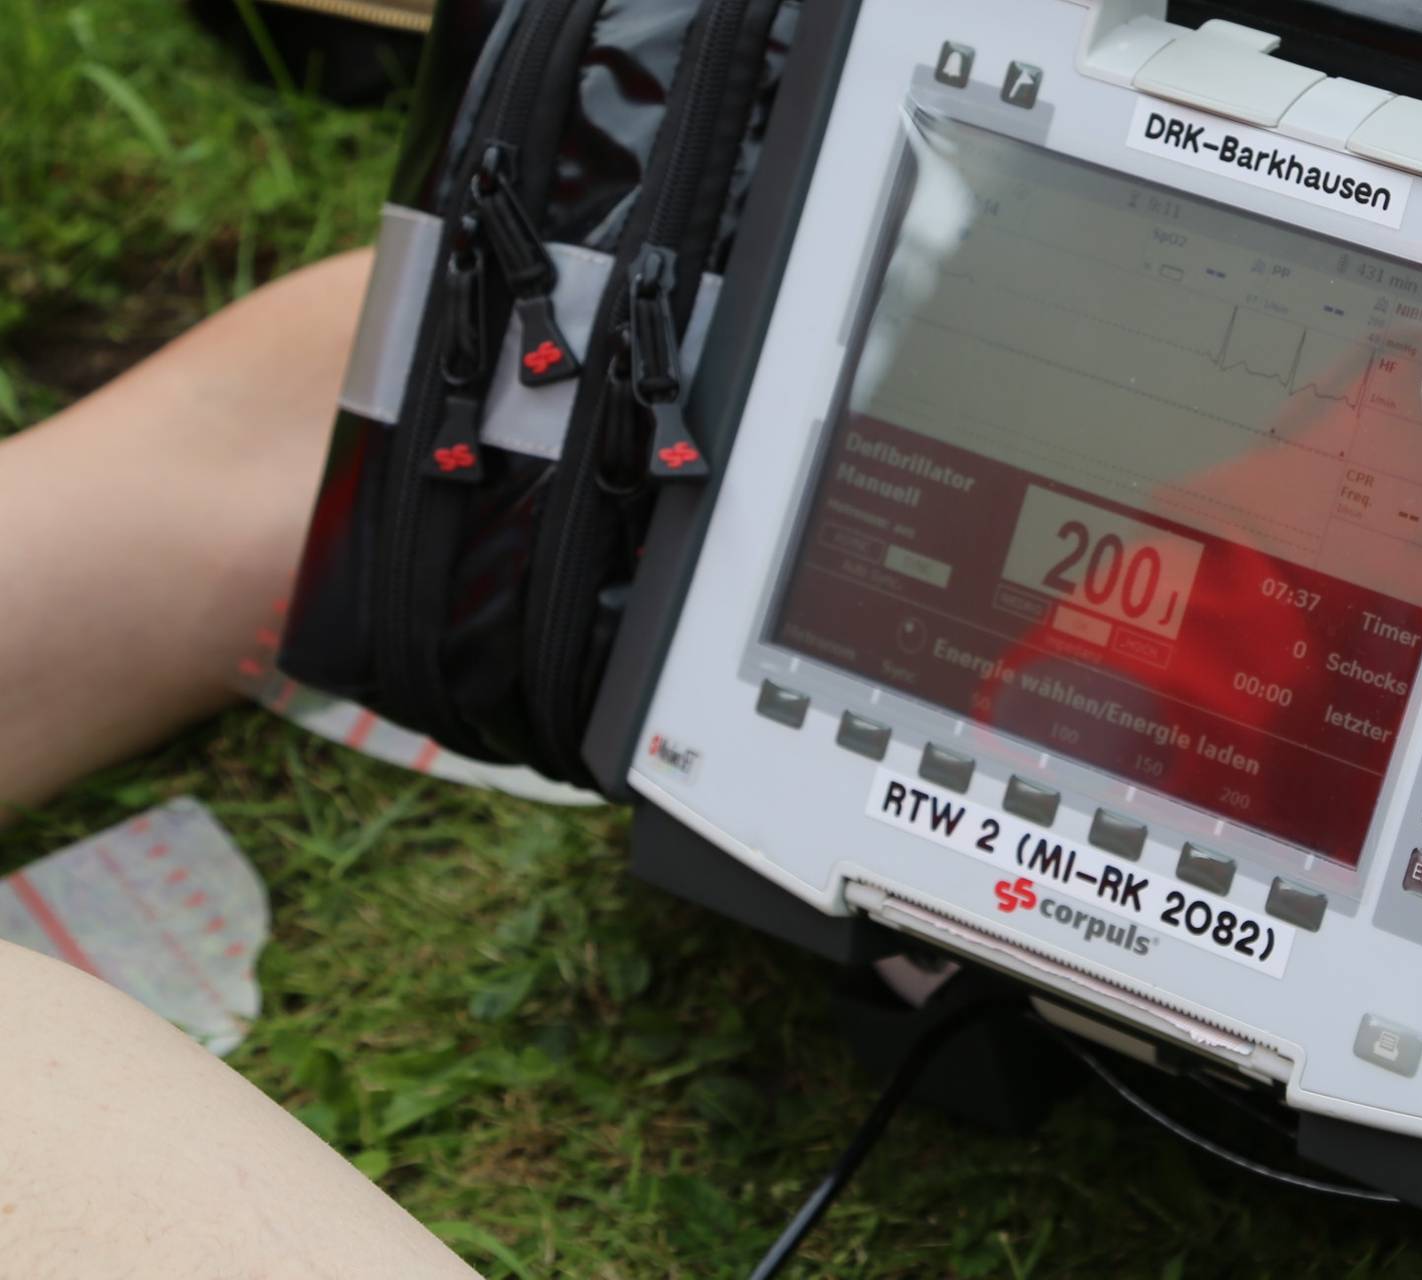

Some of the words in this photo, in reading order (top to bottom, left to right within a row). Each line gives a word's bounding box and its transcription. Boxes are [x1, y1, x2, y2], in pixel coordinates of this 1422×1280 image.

[1144, 112, 1392, 211] DRK-Barkhausen
[845, 432, 977, 494] Defibrillator
[1345, 469, 1376, 489] CPR
[835, 462, 923, 509] Manuell
[1260, 578, 1323, 613] 07:37
[1291, 640, 1308, 660] 0
[1361, 610, 1422, 650] Timer
[1232, 671, 1294, 708] 00:00
[1325, 651, 1409, 697] Schocks
[932, 635, 1017, 684] Energie
[1196, 735, 1261, 777] laden
[1322, 704, 1393, 744] letzter
[1050, 722, 1081, 745] 100
[1135, 753, 1164, 777] 150
[1218, 786, 1251, 811] 200
[882, 781, 965, 837] RTW
[976, 819, 1000, 853] 2
[1016, 832, 1150, 912] (MI-RK
[1160, 890, 1276, 962] 2082)
